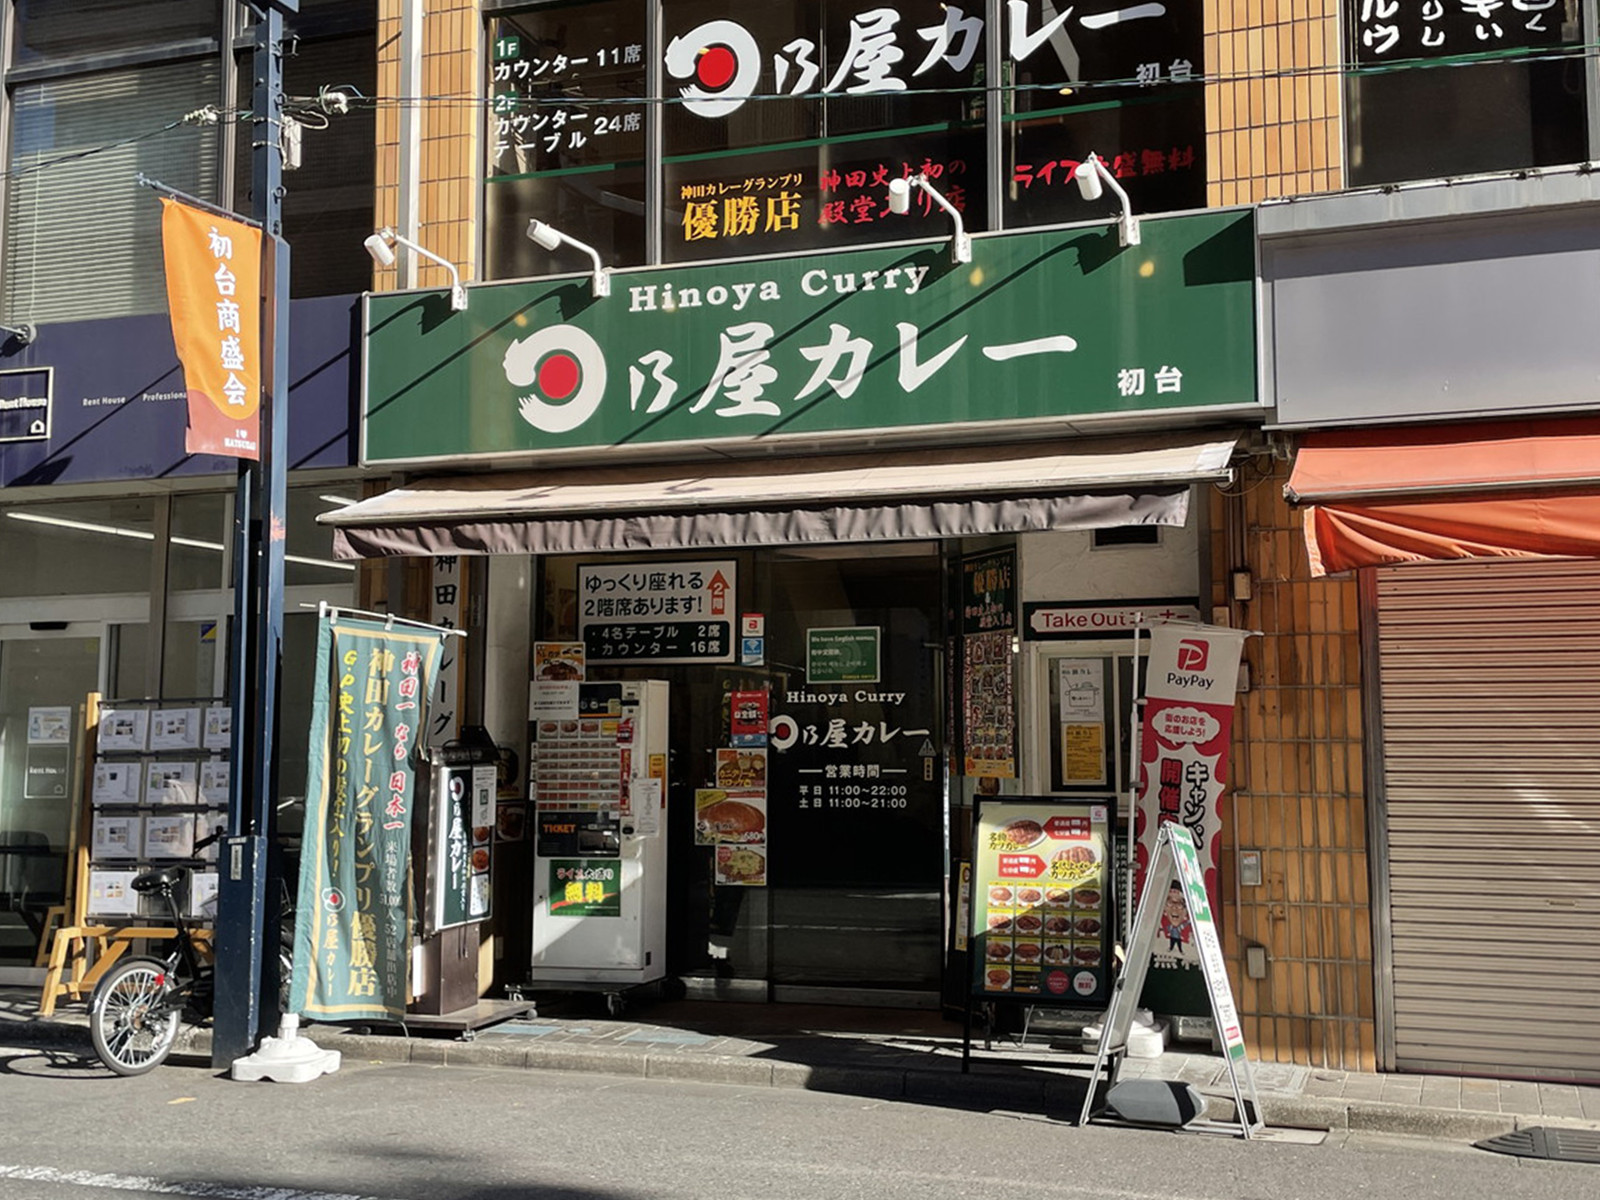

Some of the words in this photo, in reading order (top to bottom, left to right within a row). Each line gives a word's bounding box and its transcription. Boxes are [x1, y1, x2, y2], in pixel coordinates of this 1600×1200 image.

[497, 39, 517, 57] 1F
[494, 54, 589, 81] カウンター
[597, 44, 642, 67] 11席
[494, 109, 588, 136] カウンター
[594, 112, 641, 136] 24席
[494, 131, 587, 159] テーブル
[681, 173, 802, 200] 神田カレーグランプリ
[681, 190, 802, 242] 優勝店
[629, 283, 781, 312] Hinoya
[800, 264, 930, 296] Curry
[207, 226, 247, 406] 初台商盛会
[1117, 365, 1184, 397] 初台
[102, 396, 126, 405] House
[584, 572, 704, 594] ゆっくり座れる
[584, 595, 703, 617] 2階席あります!
[1042, 611, 1088, 627] Take
[1091, 611, 1126, 627] Out
[698, 624, 721, 637] 2席
[602, 642, 678, 656] カウンター
[690, 640, 721, 654] 16席
[1167, 672, 1214, 690] PayPay
[787, 691, 848, 705] Hinoya
[855, 690, 906, 704] Curry
[825, 764, 880, 778] 営業時間
[799, 785, 822, 795] 平日
[799, 798, 822, 808] 土日
